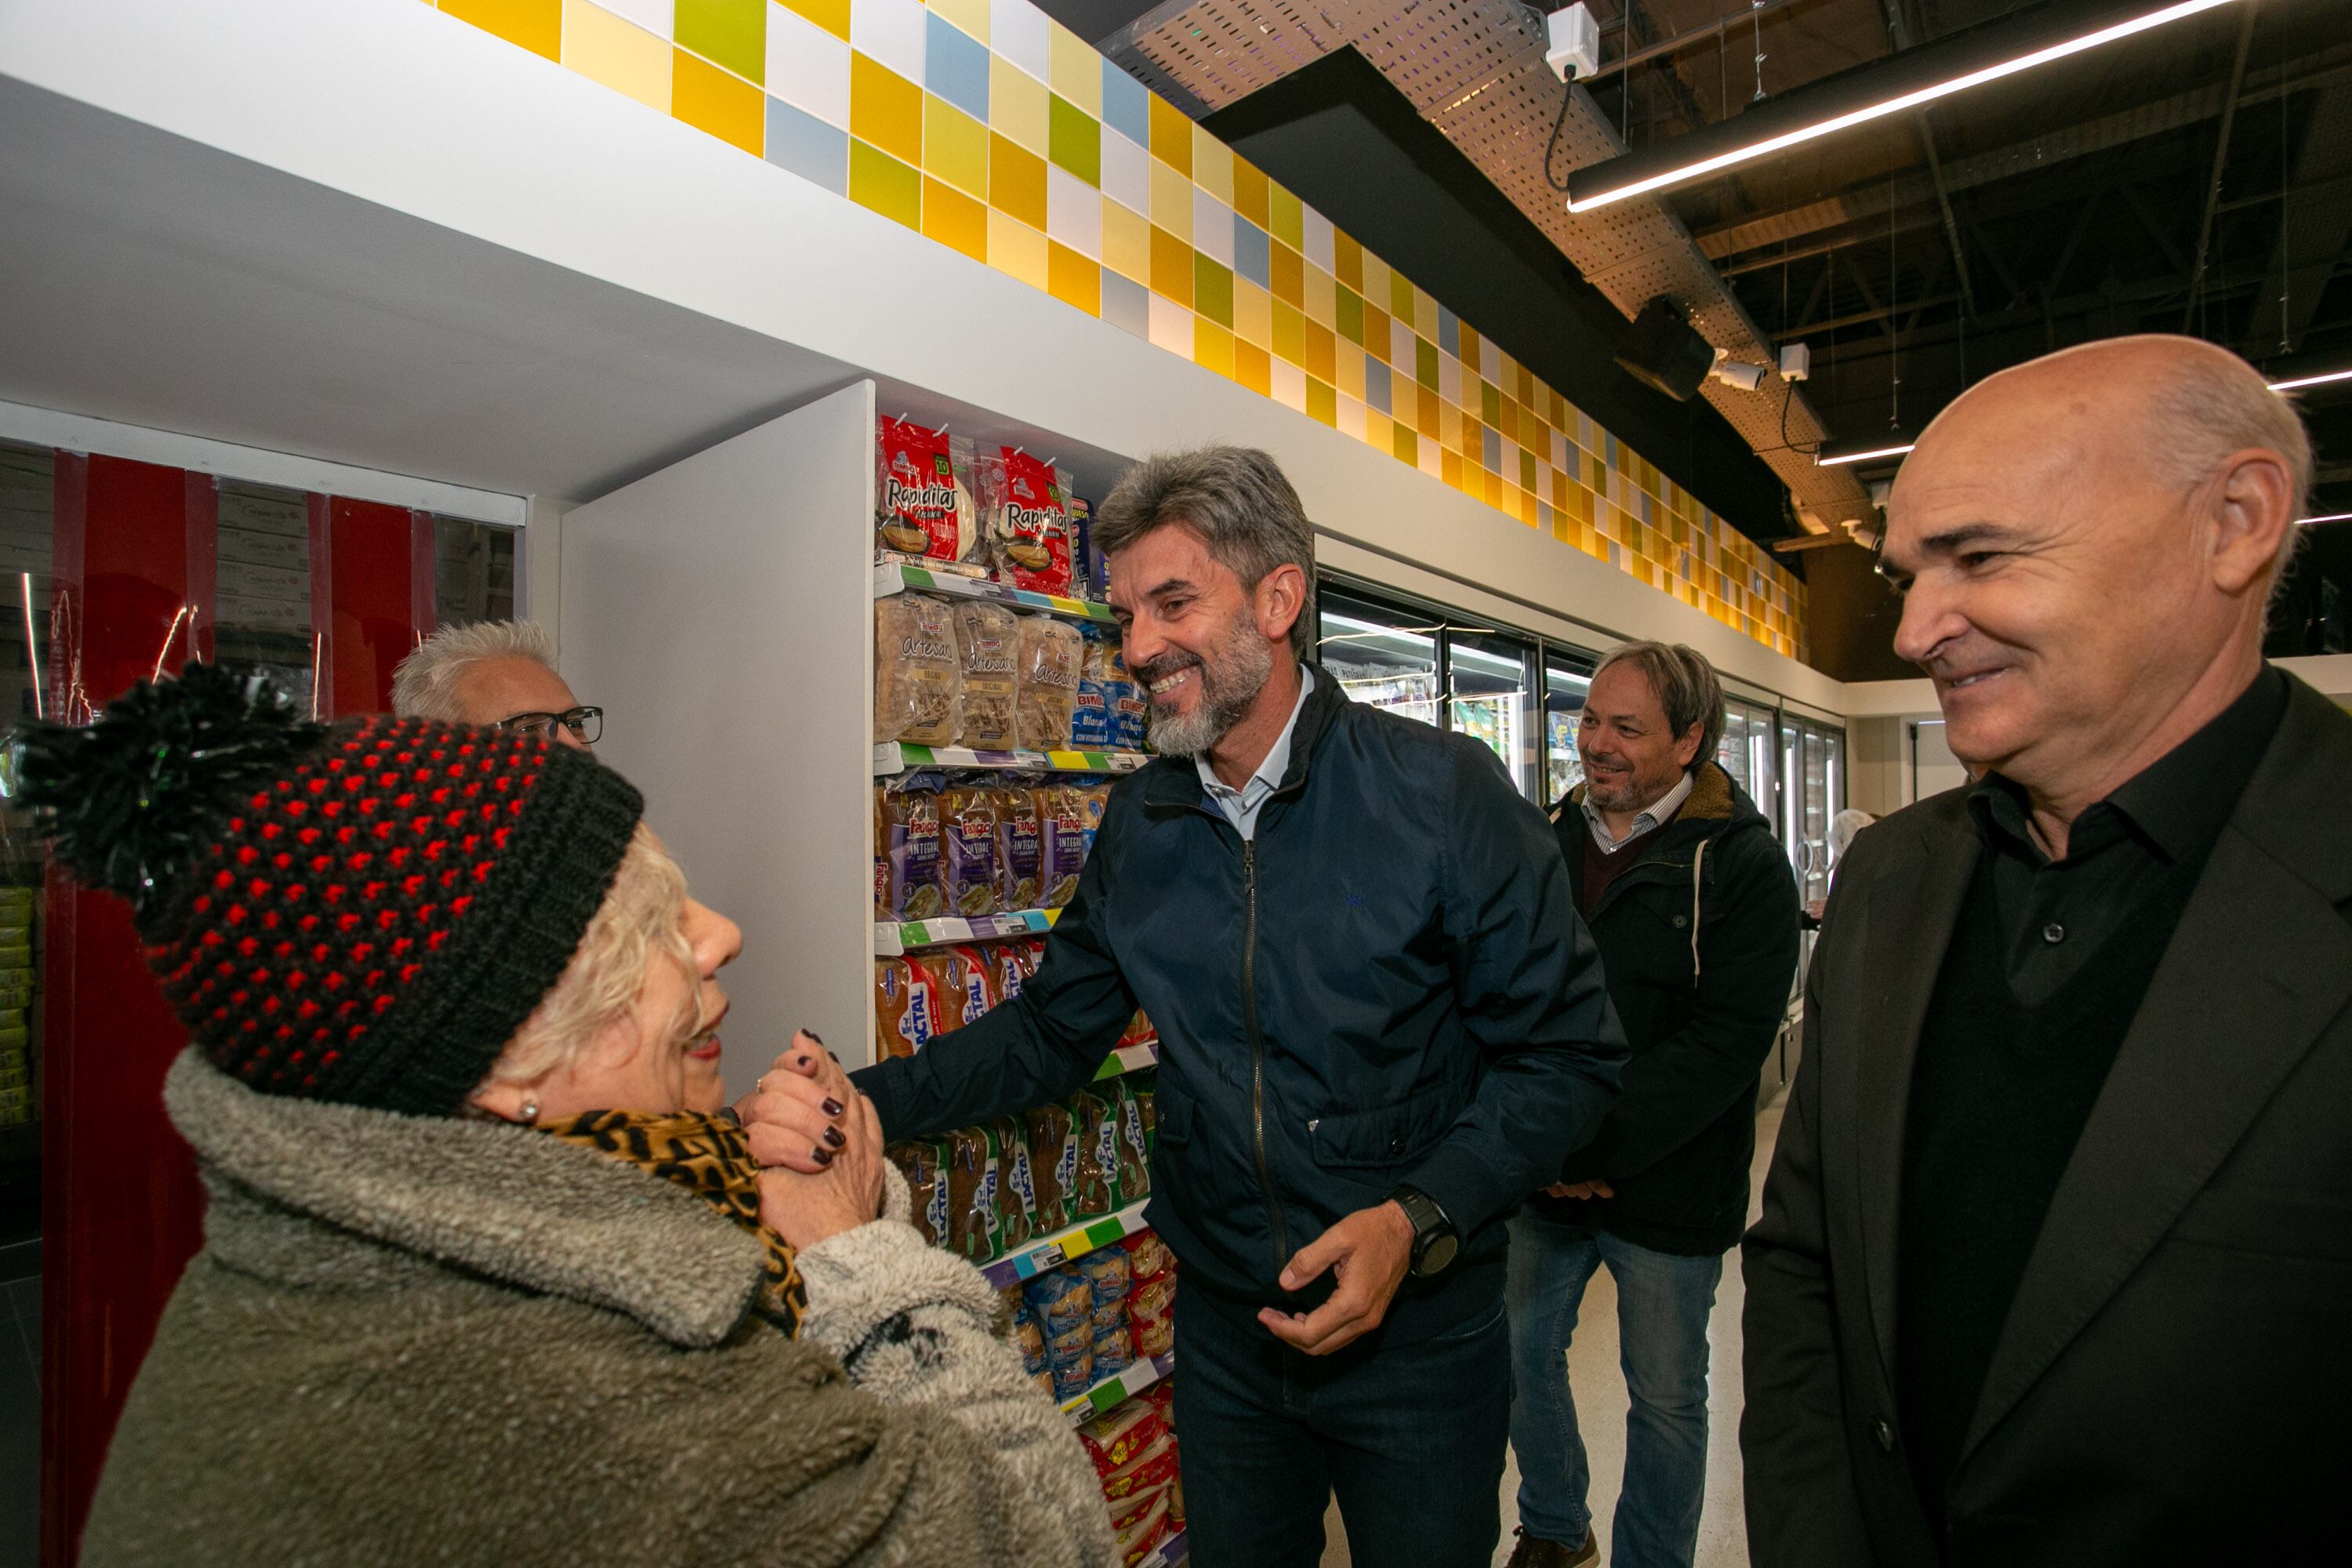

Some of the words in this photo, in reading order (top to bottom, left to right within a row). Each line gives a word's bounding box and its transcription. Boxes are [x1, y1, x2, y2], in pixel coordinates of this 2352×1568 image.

[887, 478, 958, 510] Rapiditas
[1007, 503, 1068, 533] Rapiditas
[924, 670, 943, 681] ORIGINA
[910, 818, 939, 837] Fargo
[961, 819, 992, 837] Fargo
[1015, 816, 1037, 835] Farg
[909, 840, 939, 855] INTEGRAL
[965, 842, 989, 855] INTGRAL
[876, 863, 887, 895] Fargo
[911, 989, 928, 1045] ACTAL
[1102, 1126, 1116, 1180] ACTAL
[1018, 1152, 1034, 1207] LACTAL
[937, 1176, 947, 1243] LACTAL
